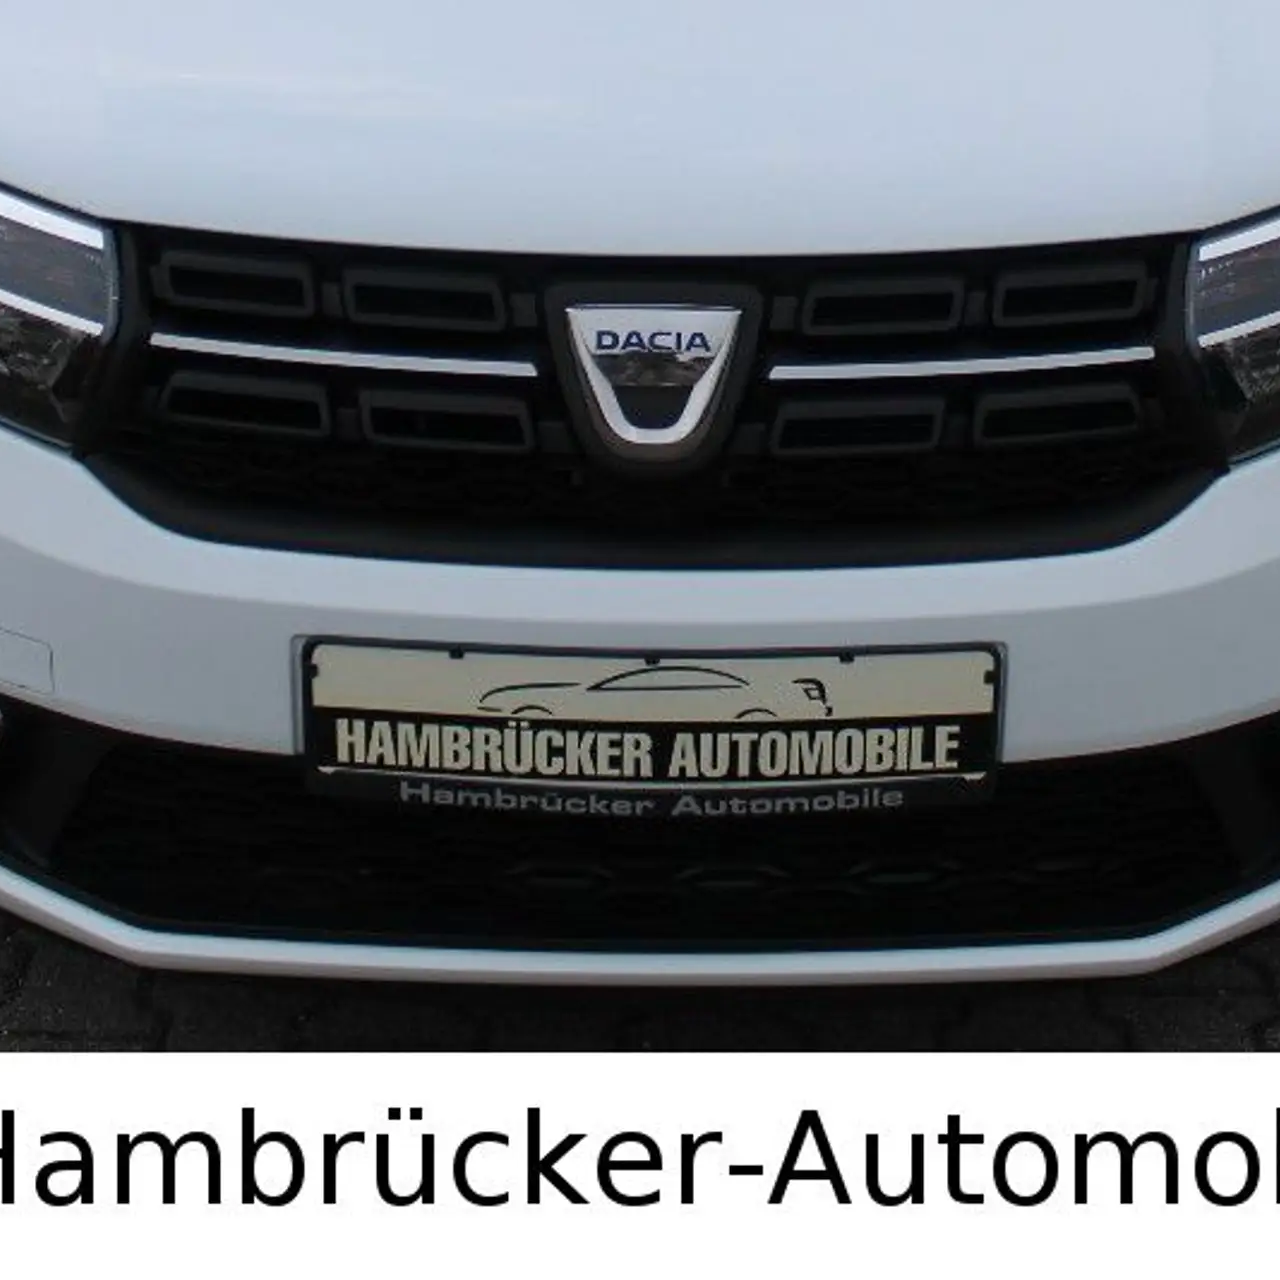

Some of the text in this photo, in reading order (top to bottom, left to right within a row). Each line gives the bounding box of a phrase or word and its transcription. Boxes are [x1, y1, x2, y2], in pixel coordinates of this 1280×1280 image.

[595, 330, 712, 353] DACIA
[336, 718, 961, 779] HAMBRÜCKER AUTOMOBILE
[398, 780, 904, 817] Hambrücker Automobile
